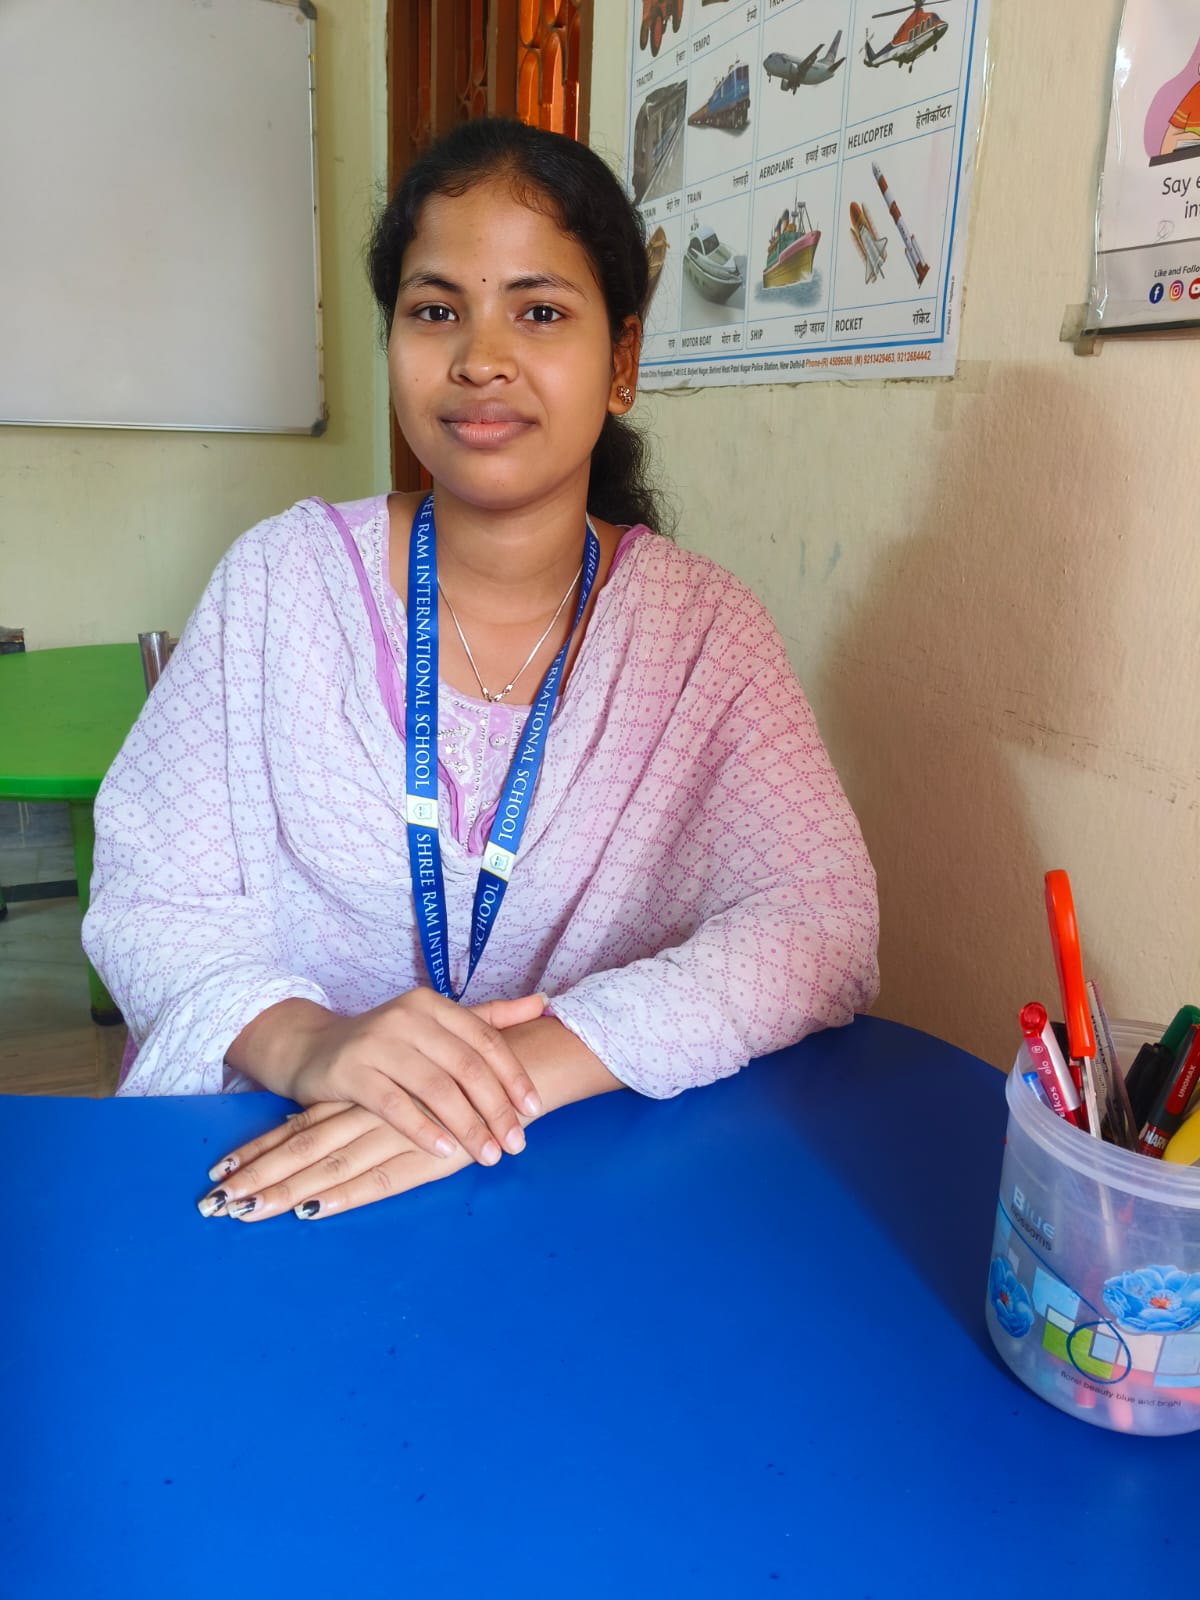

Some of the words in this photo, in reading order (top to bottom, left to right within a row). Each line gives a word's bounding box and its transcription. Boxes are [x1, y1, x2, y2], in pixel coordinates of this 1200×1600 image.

[693, 34, 711, 52] TEMPO
[636, 70, 654, 88] TRACTOR
[915, 104, 952, 129] हेलीकॉप्टर
[848, 122, 894, 150] HELICOPTER
[759, 157, 795, 180] AEROPLANE
[687, 190, 702, 204] TRAIN
[1162, 177, 1191, 197] Say
[1184, 201, 1200, 219] in
[1153, 269, 1167, 278] Like
[1168, 266, 1182, 276] and
[835, 317, 863, 332] ROCKET
[912, 308, 931, 326] रॉकेट
[700, 335, 712, 347] BOAT
[750, 329, 764, 341] SHIP
[421, 495, 434, 520] REE
[416, 523, 430, 559] RAM
[415, 564, 432, 708] INTERNATIONAL
[415, 713, 431, 789] SCHOOL
[498, 769, 530, 841] SCHOOL
[416, 833, 436, 887] SHREE
[422, 891, 439, 928] RAM
[474, 882, 500, 951] SCHOOL
[1177, 1064, 1196, 1099] UNOMAX
[1012, 1185, 1056, 1240] Blue
[1083, 1382, 1114, 1399] beauty
[1116, 1392, 1135, 1403] blue
[1138, 1397, 1154, 1407] and
